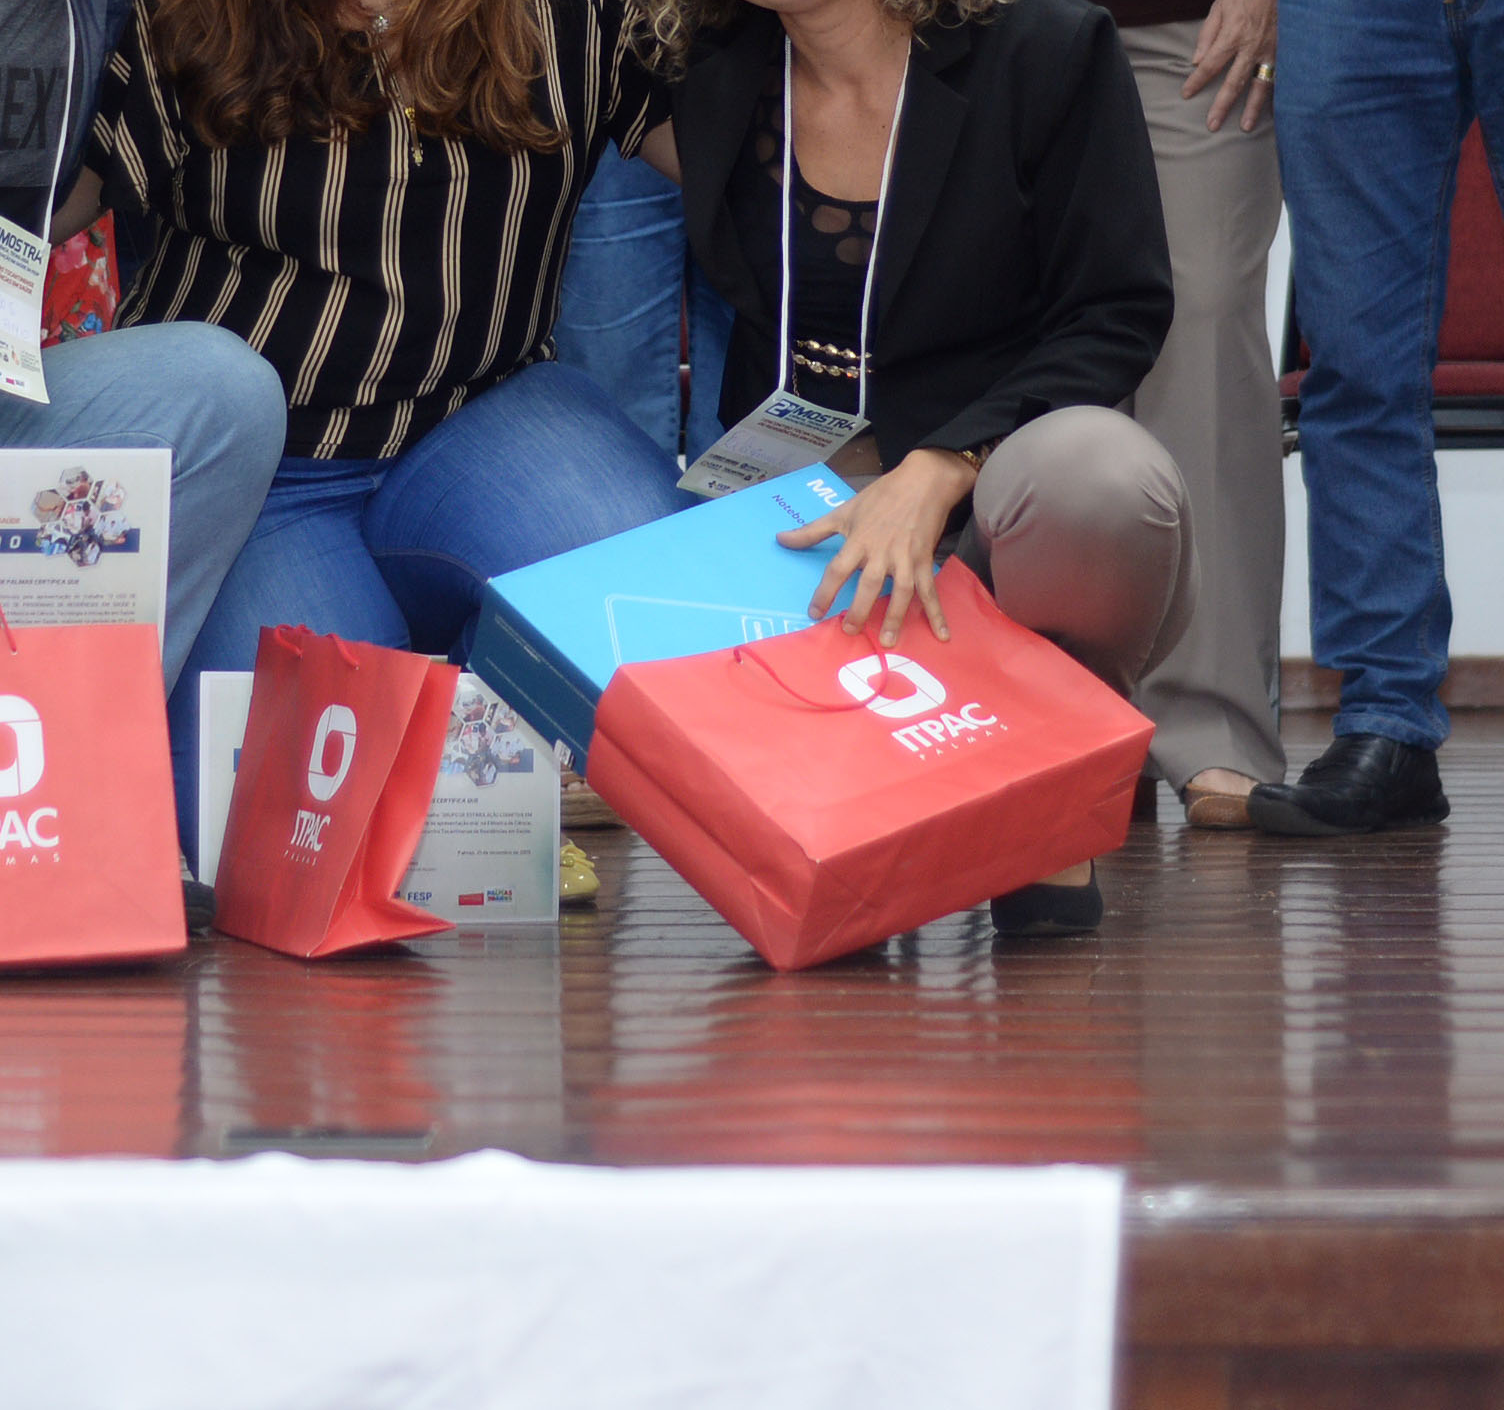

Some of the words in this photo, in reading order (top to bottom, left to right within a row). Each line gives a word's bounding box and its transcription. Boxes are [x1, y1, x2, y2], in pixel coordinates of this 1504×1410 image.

[793, 406, 854, 430] MOSTRA
[806, 478, 846, 507] MU
[891, 702, 998, 752] ITPAC
[919, 724, 1008, 760] PALMAS
[291, 809, 331, 852] ITPAC
[407, 891, 432, 901] FESP
